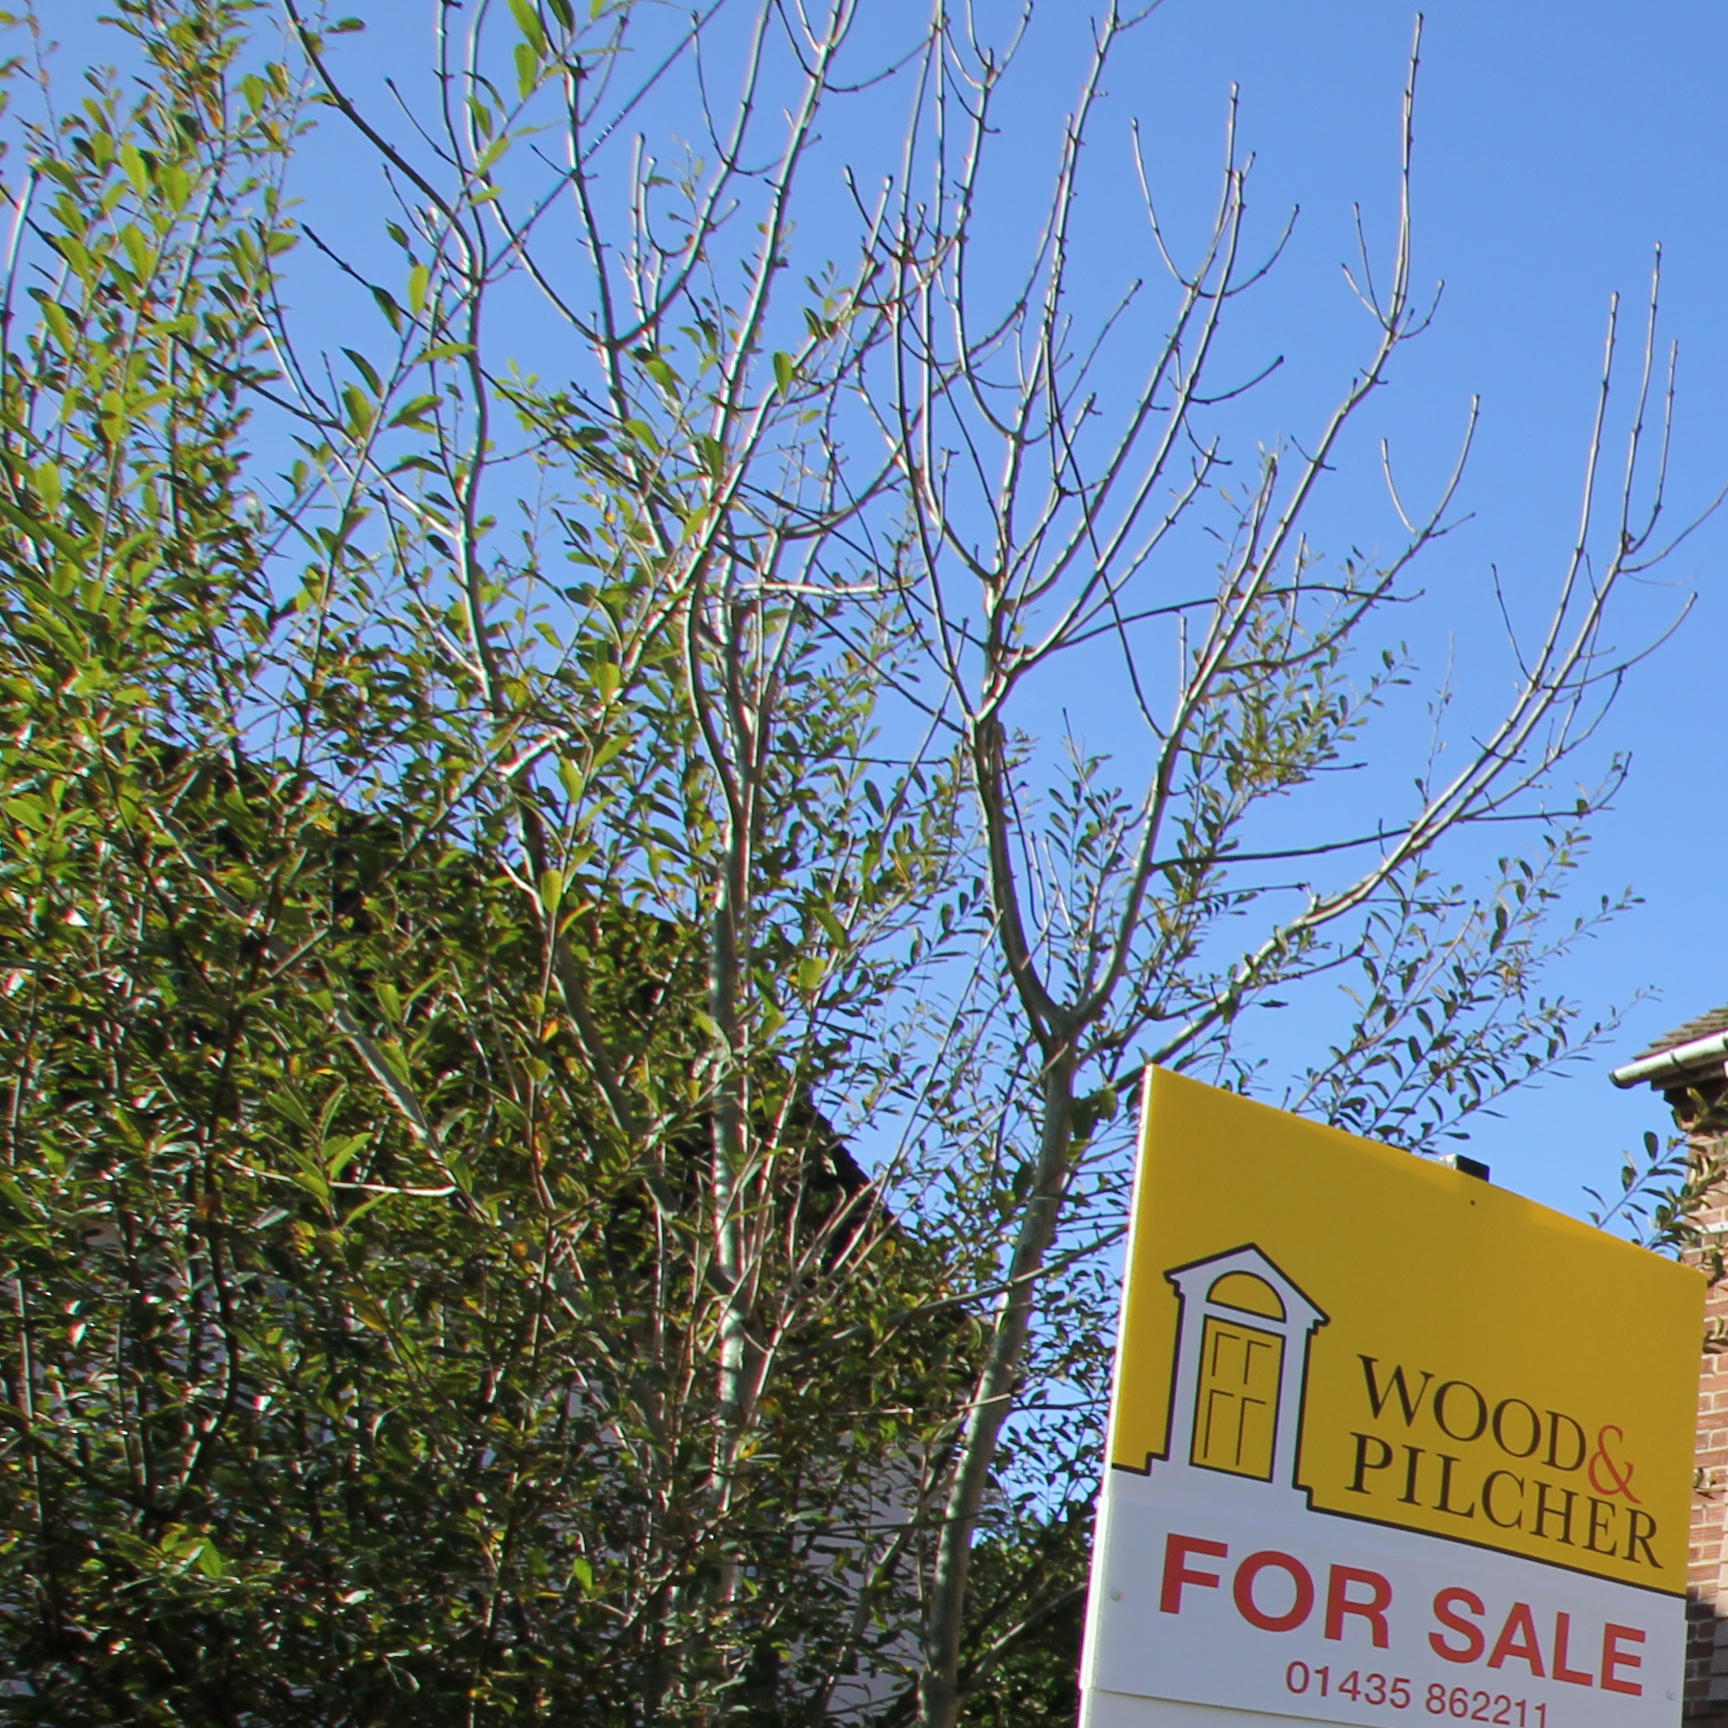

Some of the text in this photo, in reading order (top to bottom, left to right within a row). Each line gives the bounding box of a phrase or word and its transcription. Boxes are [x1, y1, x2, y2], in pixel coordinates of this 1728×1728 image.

[1345, 1431, 1664, 1569] PILCHER
[1159, 1532, 1647, 1697] FOR SALE
[1286, 1660, 1411, 1709] 01435
